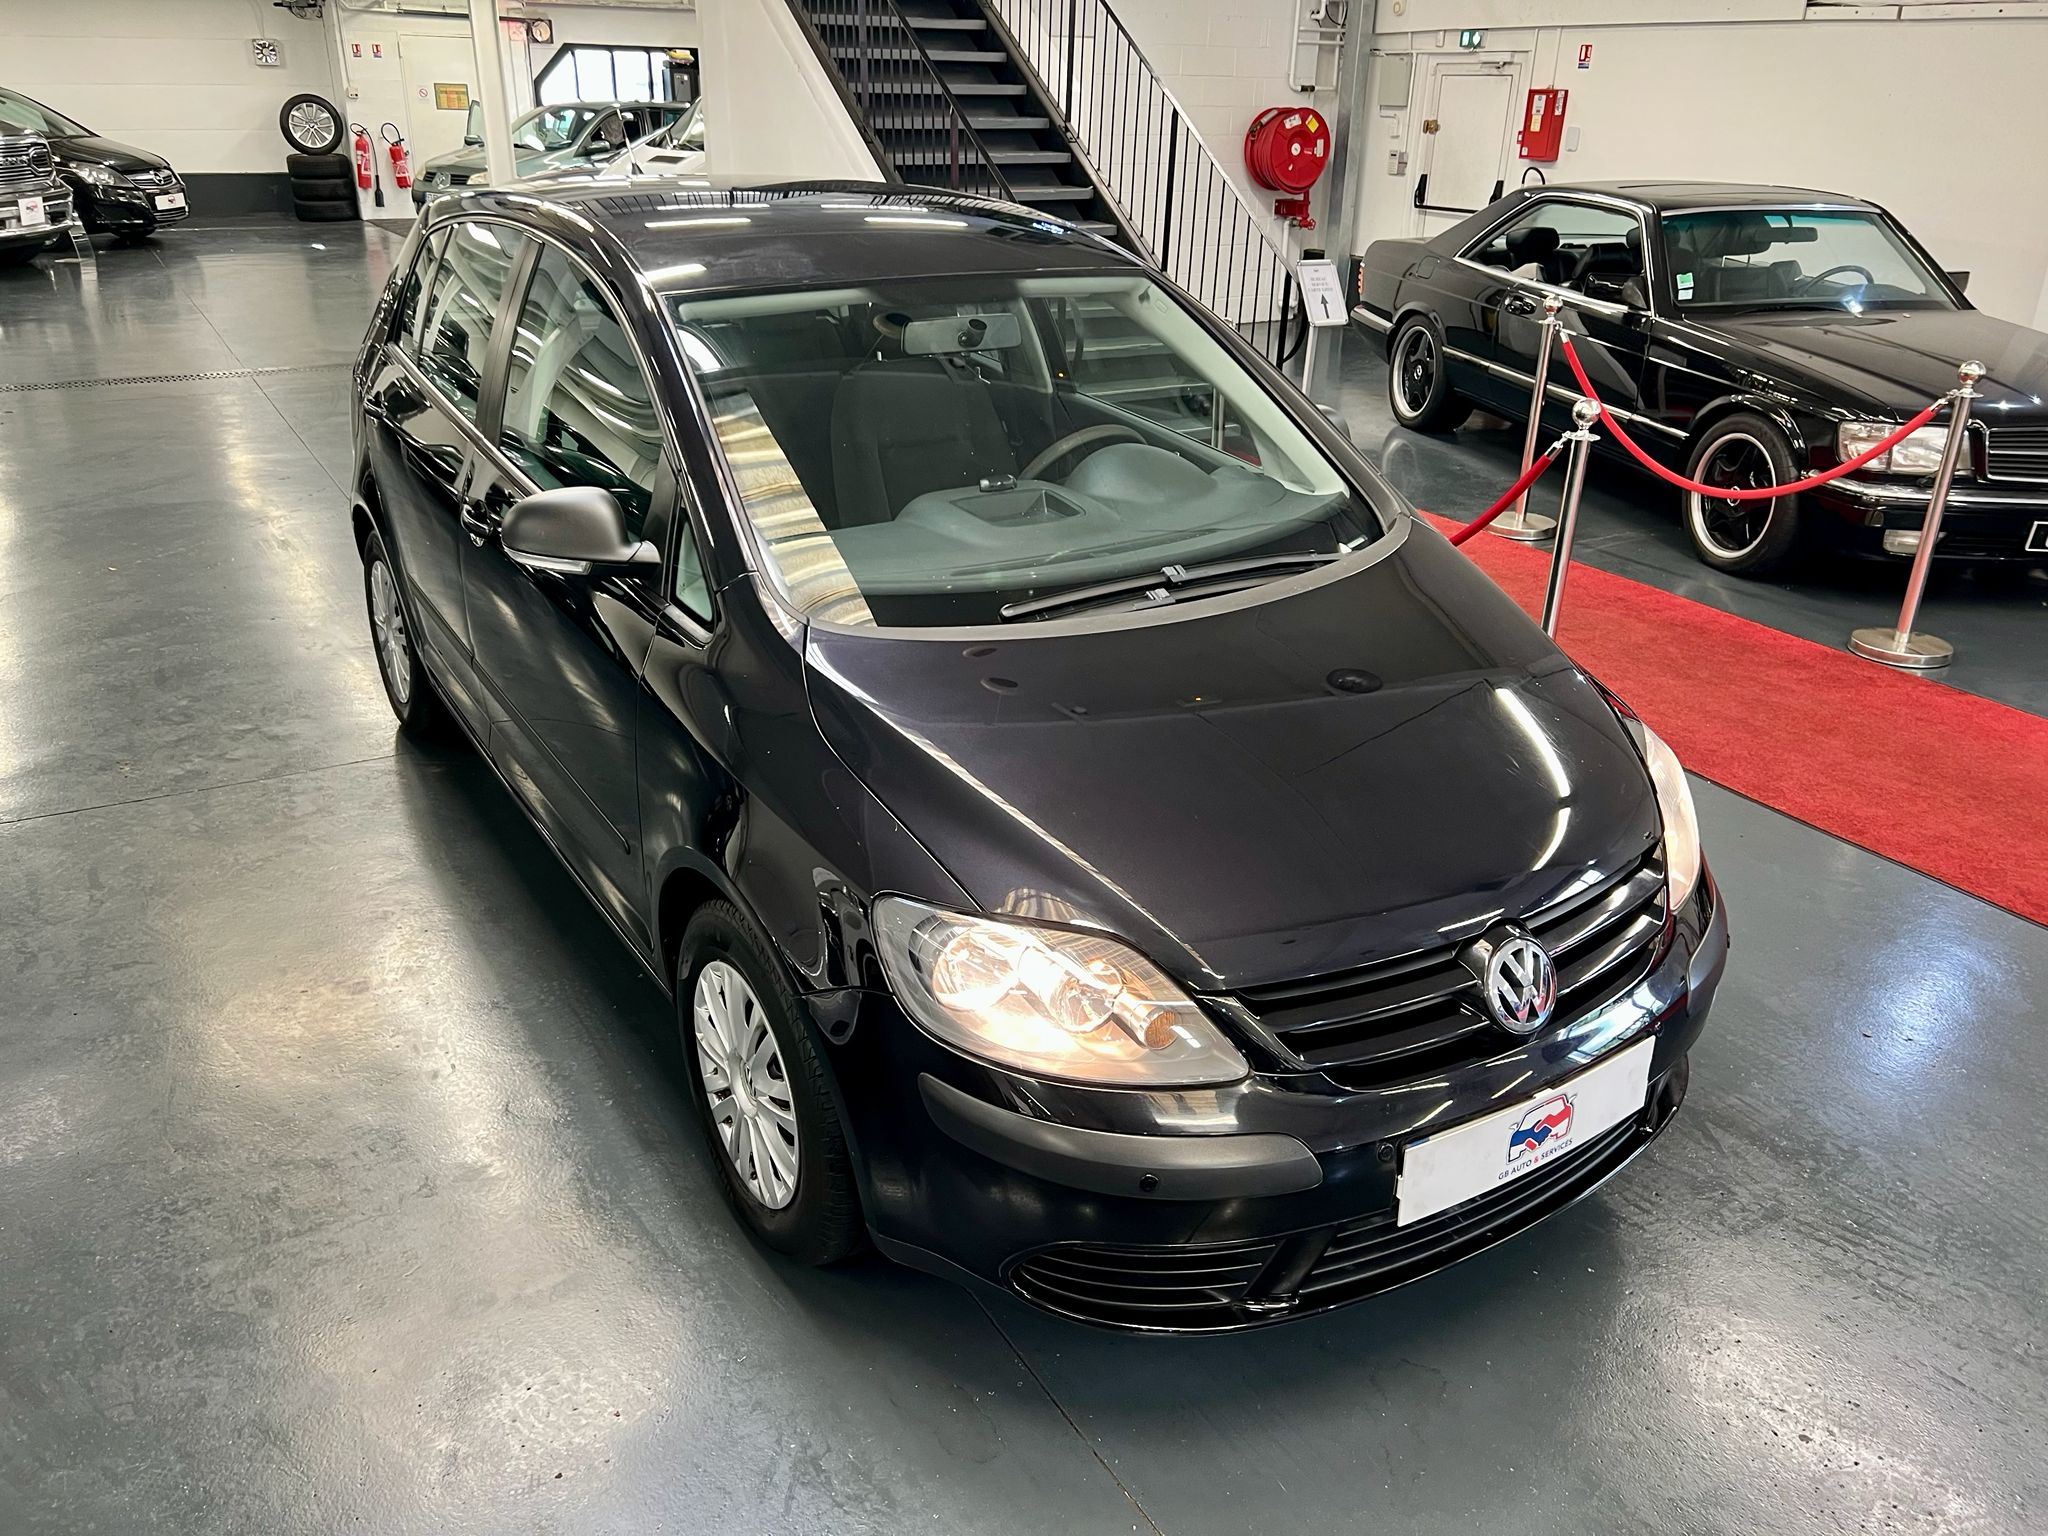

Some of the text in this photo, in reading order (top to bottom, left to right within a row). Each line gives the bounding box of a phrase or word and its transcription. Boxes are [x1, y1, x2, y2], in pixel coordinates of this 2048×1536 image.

[1498, 1169, 1509, 1180] GB
[1510, 1159, 1532, 1174] AUTO
[1541, 1137, 1573, 1160] SERVICES
